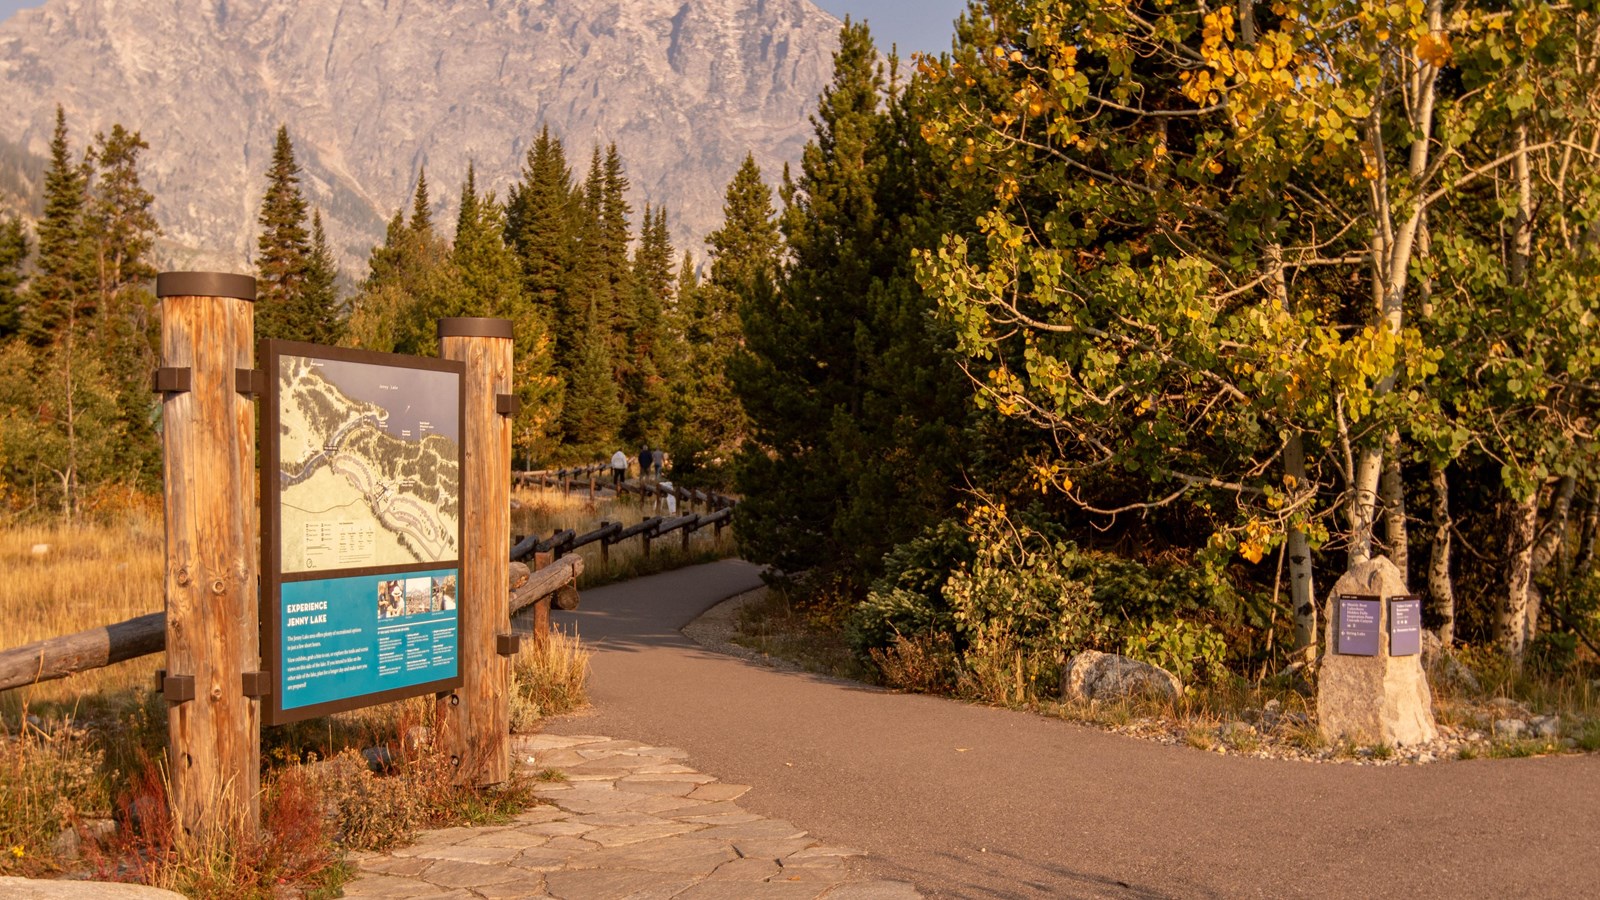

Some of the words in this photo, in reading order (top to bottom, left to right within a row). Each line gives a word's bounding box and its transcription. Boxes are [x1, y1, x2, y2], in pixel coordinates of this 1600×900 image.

[287, 601, 328, 613] EXPERIENCE
[287, 616, 309, 627] JENNY
[310, 613, 327, 624] LAKE
